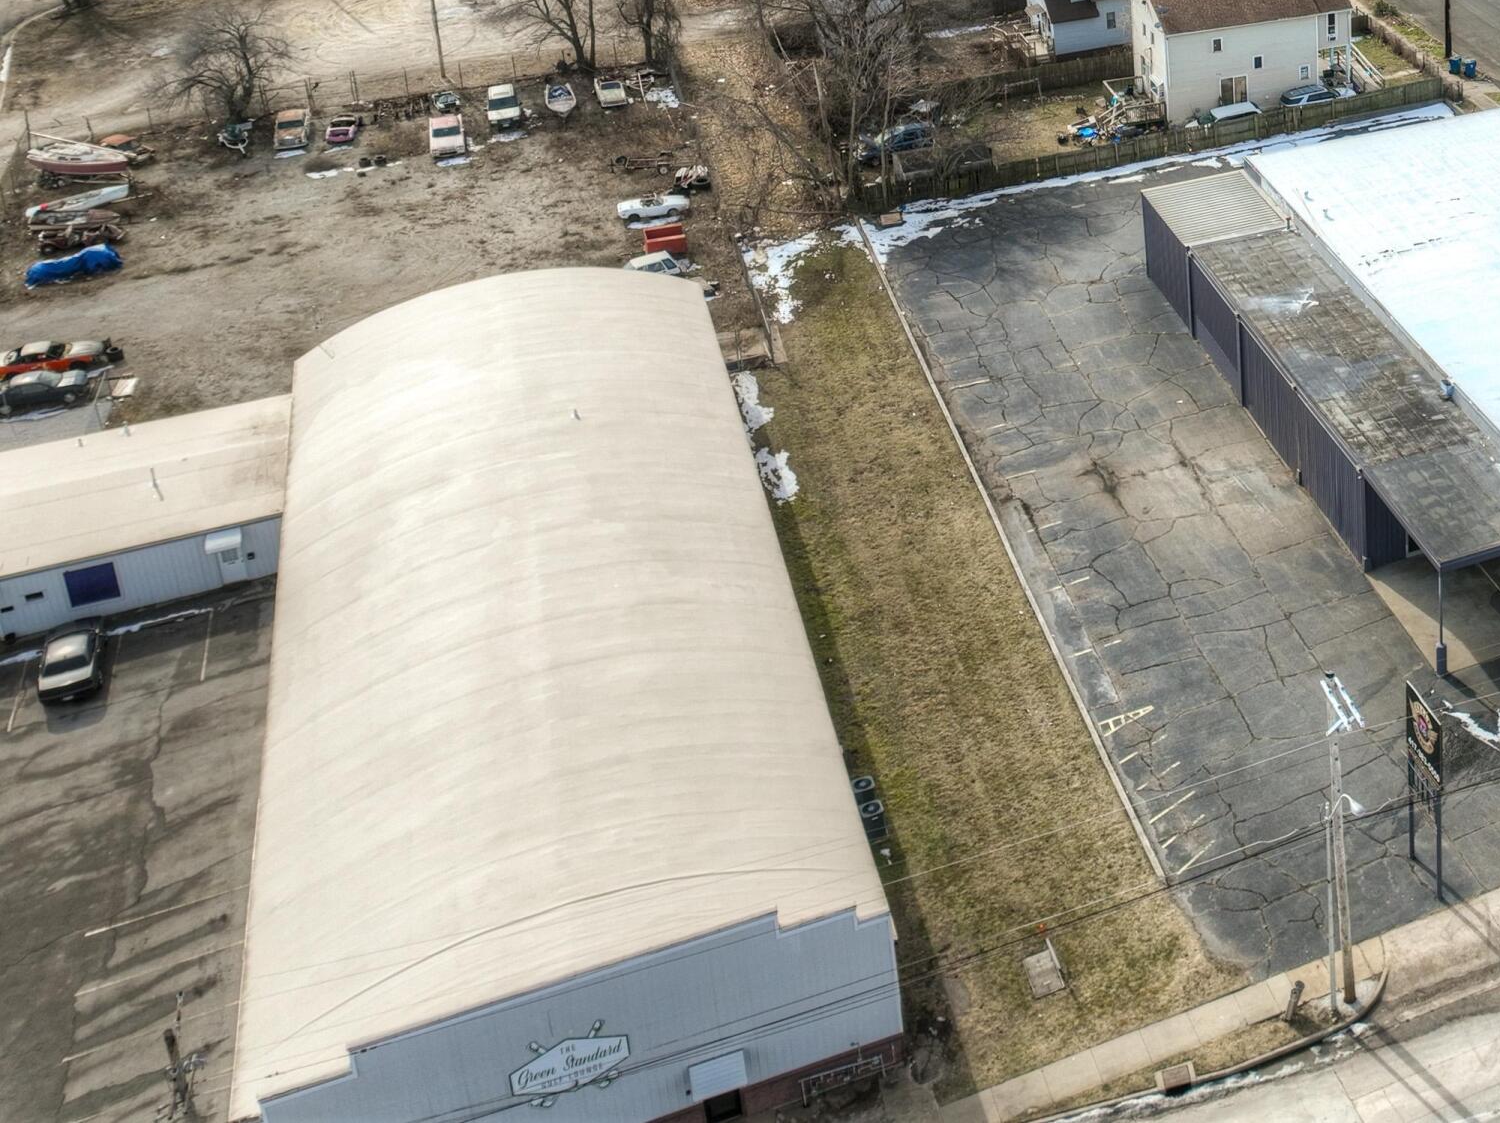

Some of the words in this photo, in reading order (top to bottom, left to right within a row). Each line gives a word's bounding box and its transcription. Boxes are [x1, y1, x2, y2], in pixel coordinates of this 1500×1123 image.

[560, 1044, 576, 1054] THE
[518, 1067, 557, 1090] Green
[563, 1039, 623, 1072] Standard
